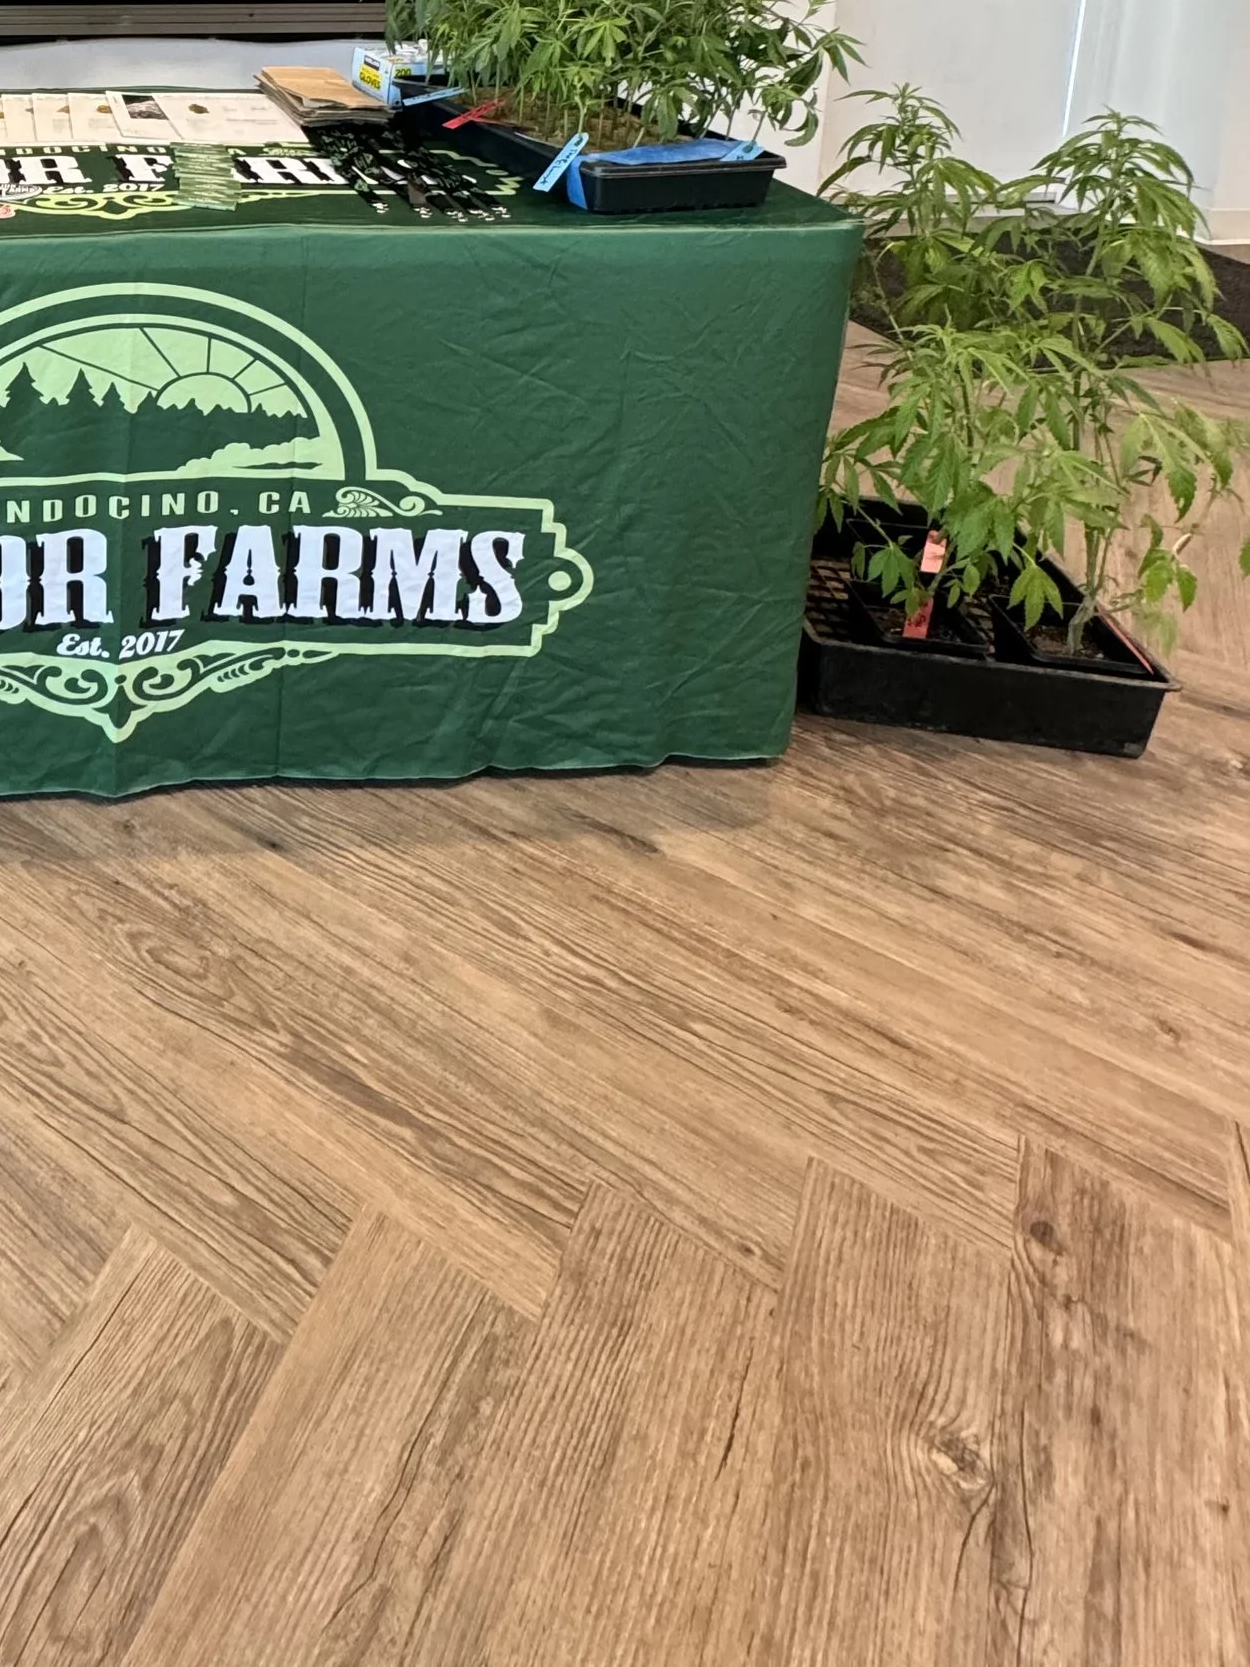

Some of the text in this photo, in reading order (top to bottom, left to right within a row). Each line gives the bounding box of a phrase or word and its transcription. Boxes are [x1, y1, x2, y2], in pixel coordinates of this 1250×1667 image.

[359, 70, 381, 90] GLOVES
[395, 67, 412, 77] 200
[102, 182, 165, 193] 2017
[258, 489, 311, 517] CA
[149, 523, 525, 627] FARMS
[55, 629, 186, 659] Est. 2017
